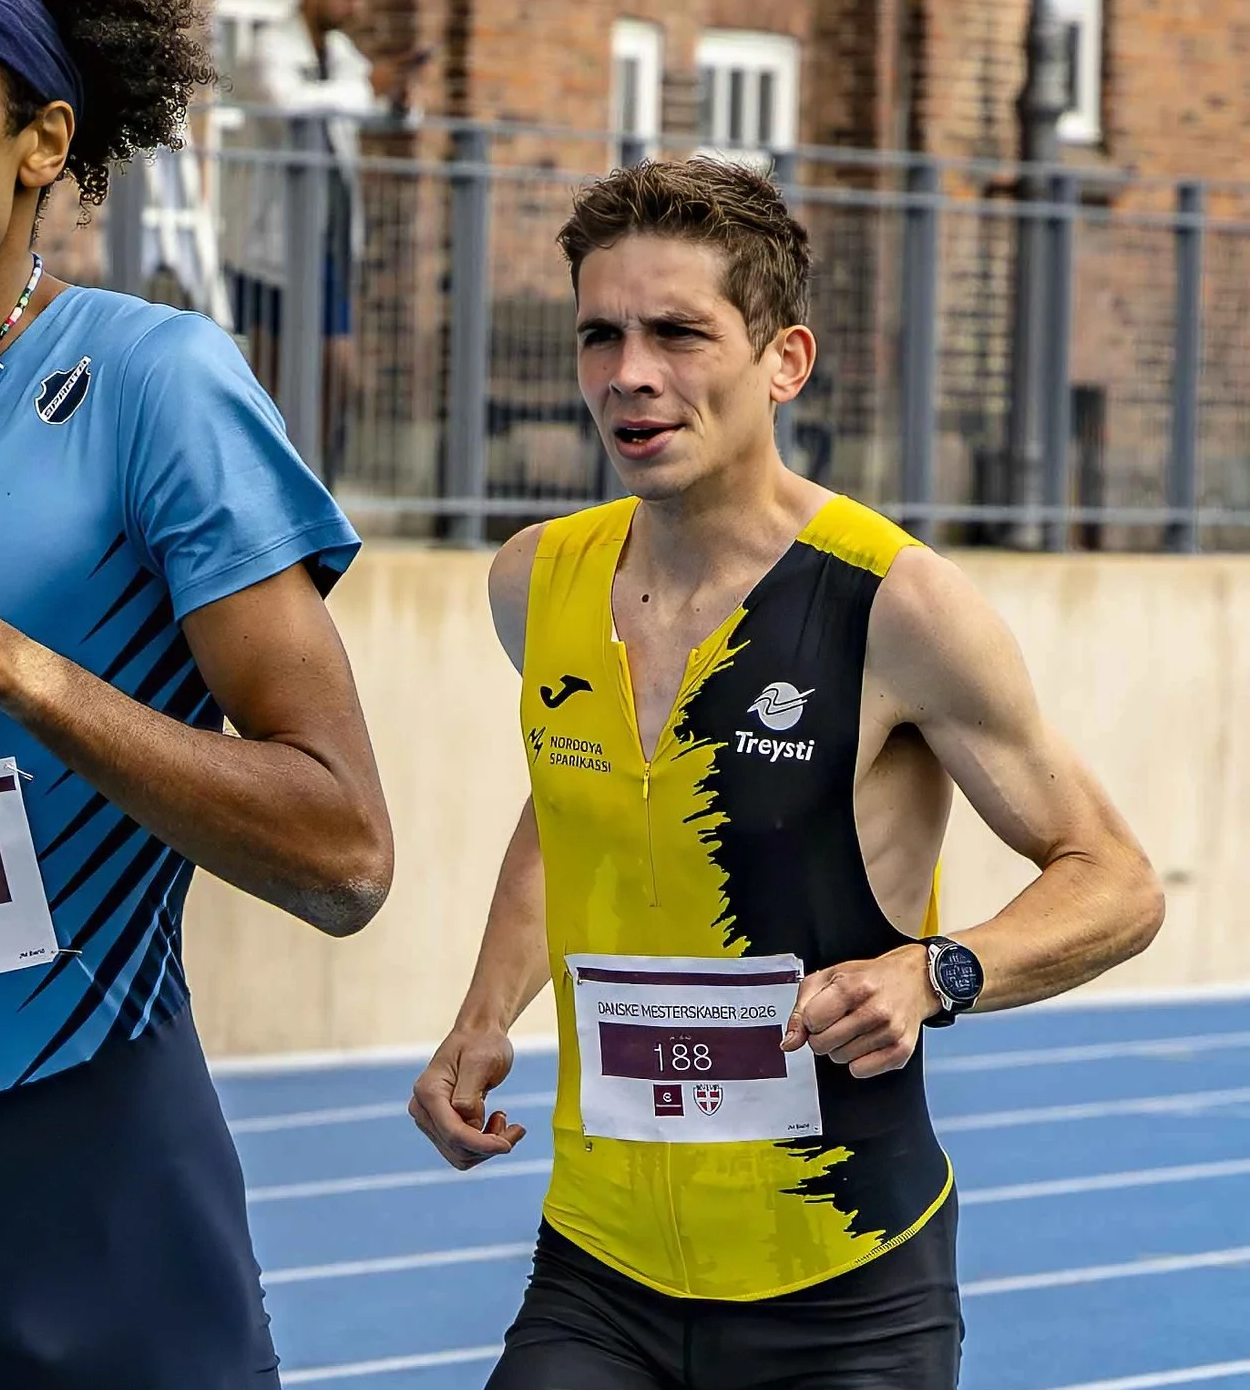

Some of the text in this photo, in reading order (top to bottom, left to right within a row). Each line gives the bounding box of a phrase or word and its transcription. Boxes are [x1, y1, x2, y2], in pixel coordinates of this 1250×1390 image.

[734, 731, 815, 762] Treysti
[598, 1001, 777, 1020] DANSKE MESTERSKABER 2026
[653, 1043, 713, 1072] 188
